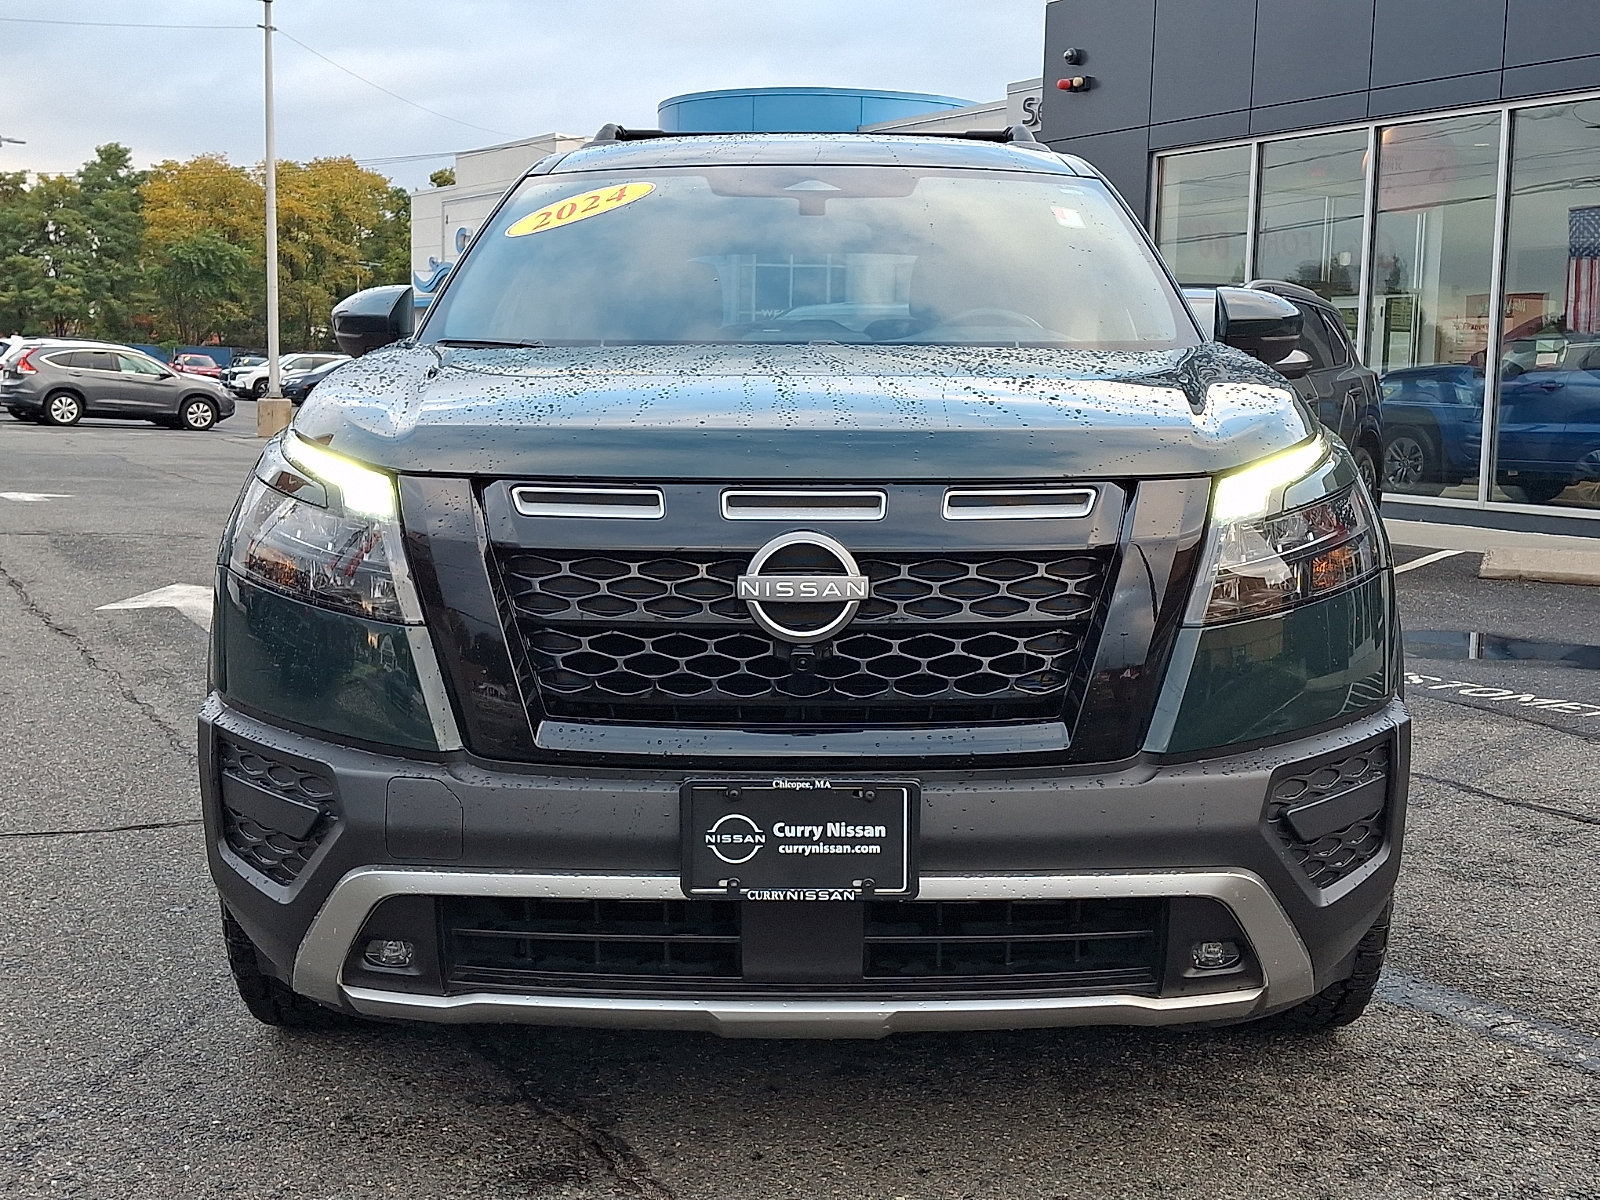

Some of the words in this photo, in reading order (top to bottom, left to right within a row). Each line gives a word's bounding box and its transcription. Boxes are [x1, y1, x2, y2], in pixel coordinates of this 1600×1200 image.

[1022, 97, 1042, 126] S
[532, 185, 628, 231] 2024
[741, 581, 865, 597] NISSAN
[772, 780, 813, 790] Chicopee,
[815, 780, 831, 789] MA
[705, 834, 766, 843] NISSAN
[773, 822, 824, 841] Curry
[827, 822, 886, 838] Nissan
[778, 842, 881, 856] currynissan.com
